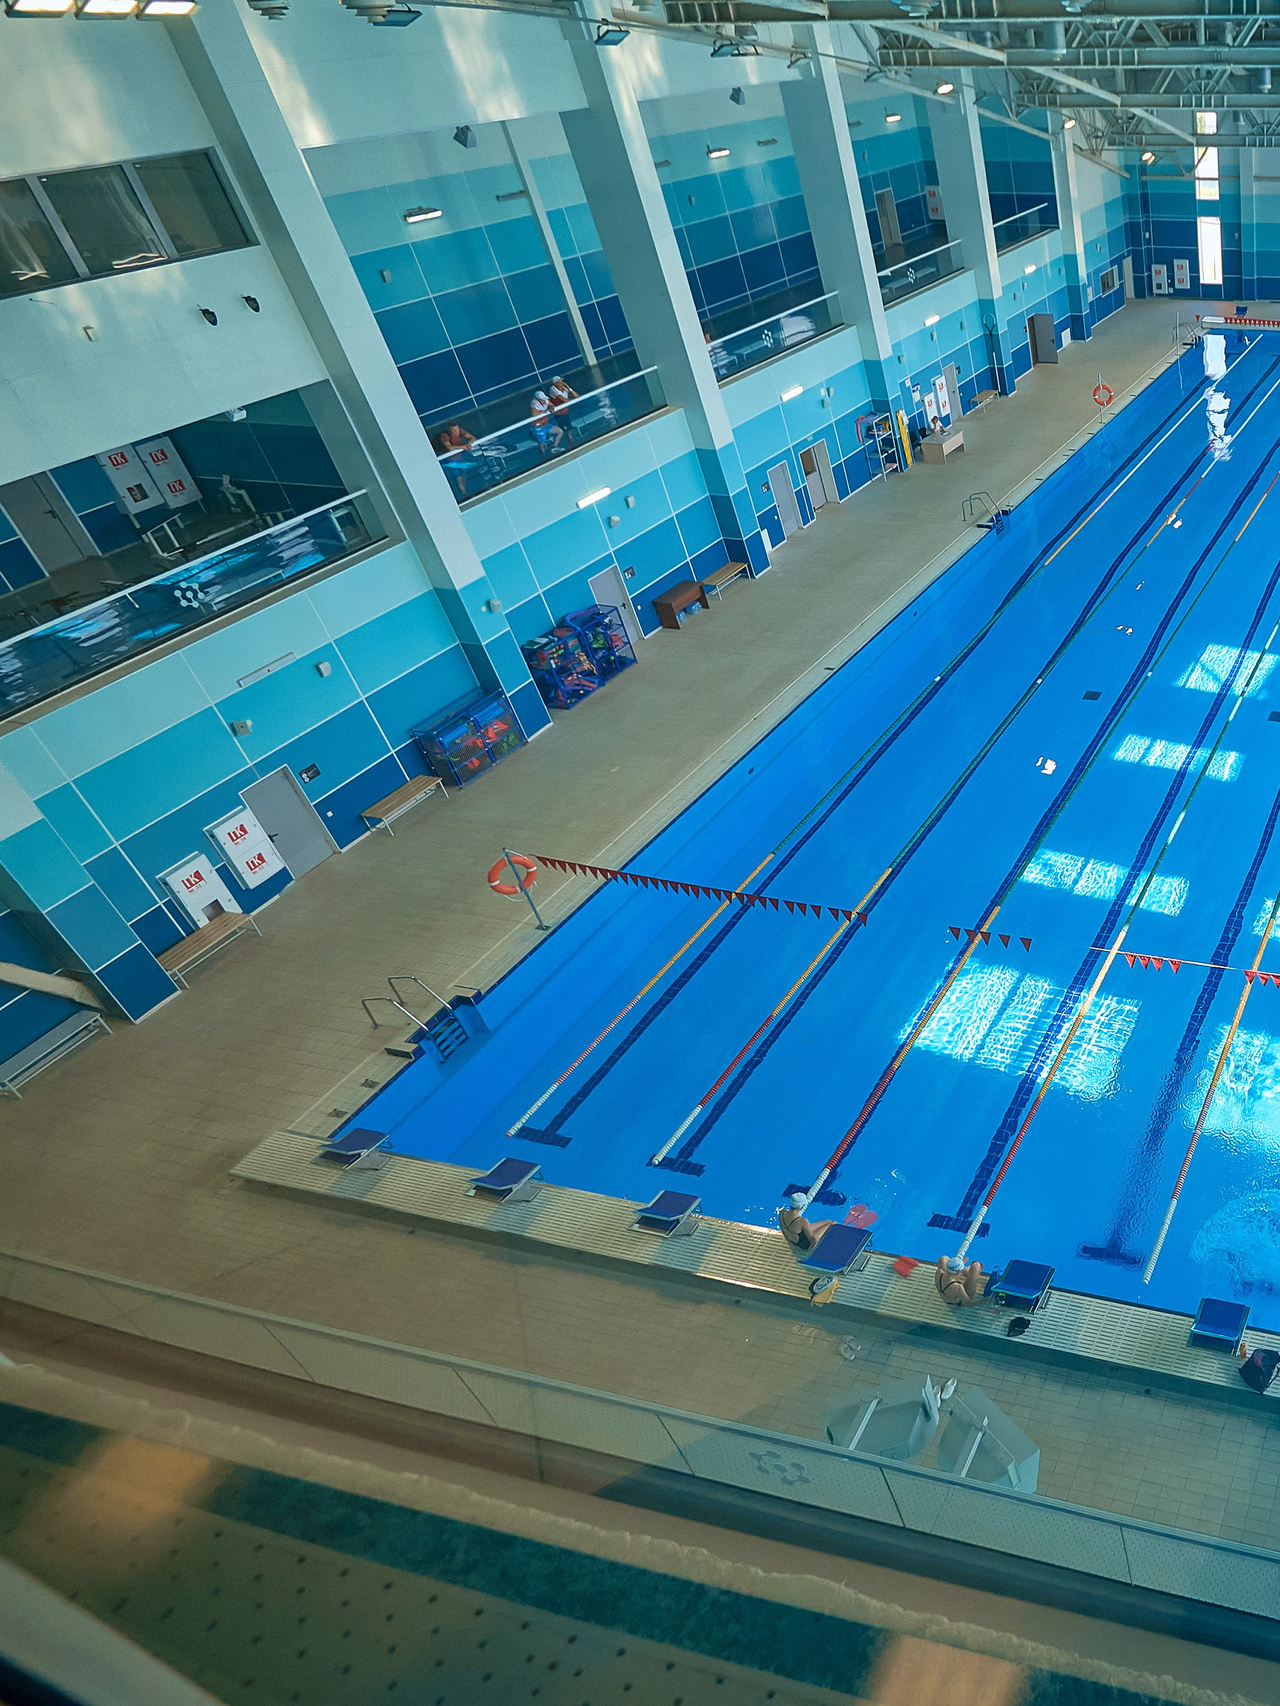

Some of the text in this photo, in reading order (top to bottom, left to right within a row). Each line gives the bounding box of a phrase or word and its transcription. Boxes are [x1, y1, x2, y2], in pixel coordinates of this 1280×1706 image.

[110, 453, 126, 466] ПК
[151, 449, 166, 462] ПК
[169, 480, 183, 493] ПК
[229, 825, 246, 841] ПК
[247, 855, 263, 870] ПК
[183, 872, 200, 889] ПК
